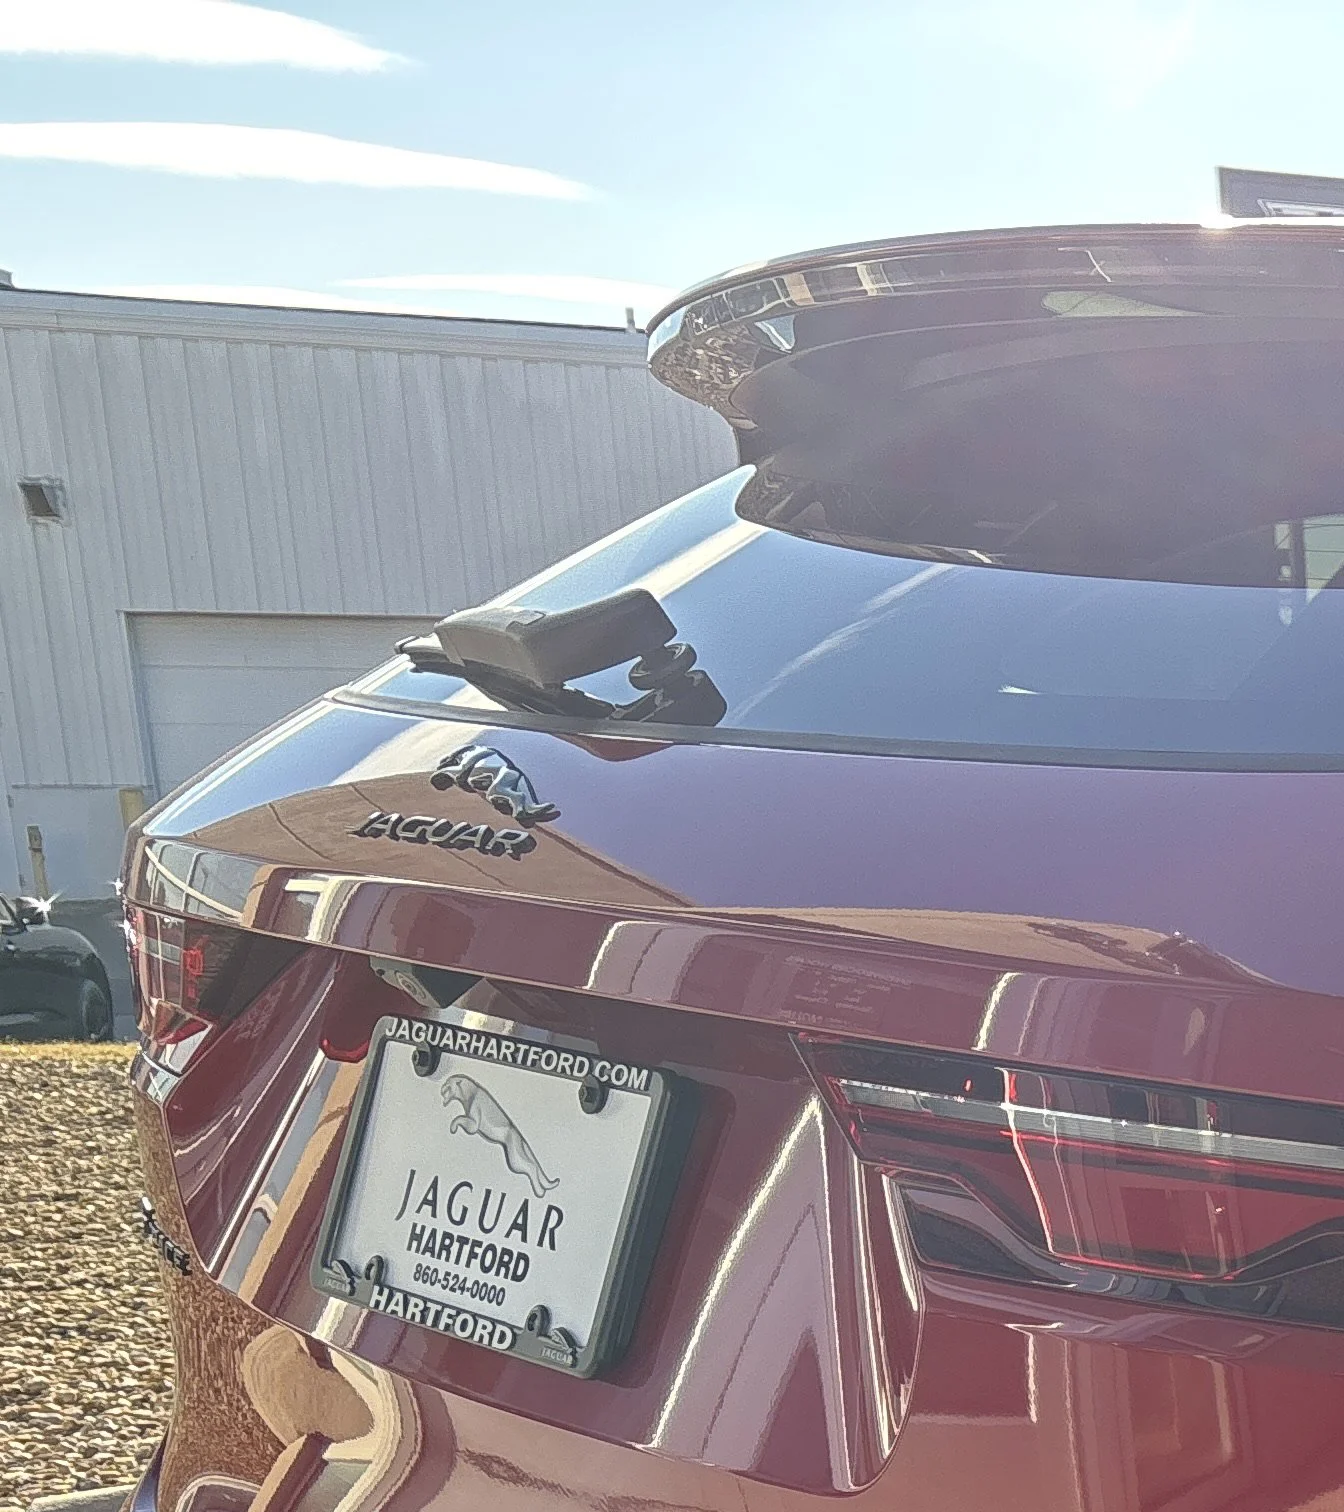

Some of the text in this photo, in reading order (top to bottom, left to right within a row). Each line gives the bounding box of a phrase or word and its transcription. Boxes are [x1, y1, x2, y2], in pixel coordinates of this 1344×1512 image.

[347, 811, 531, 859] JAGUAR
[385, 1017, 649, 1091] JAGUARHARTFORDCOM
[395, 1168, 565, 1251] JAGUAR
[406, 1222, 530, 1283] HARTFORD
[413, 1262, 506, 1307] 860-524-0000
[368, 1286, 516, 1351] HARTFORD
